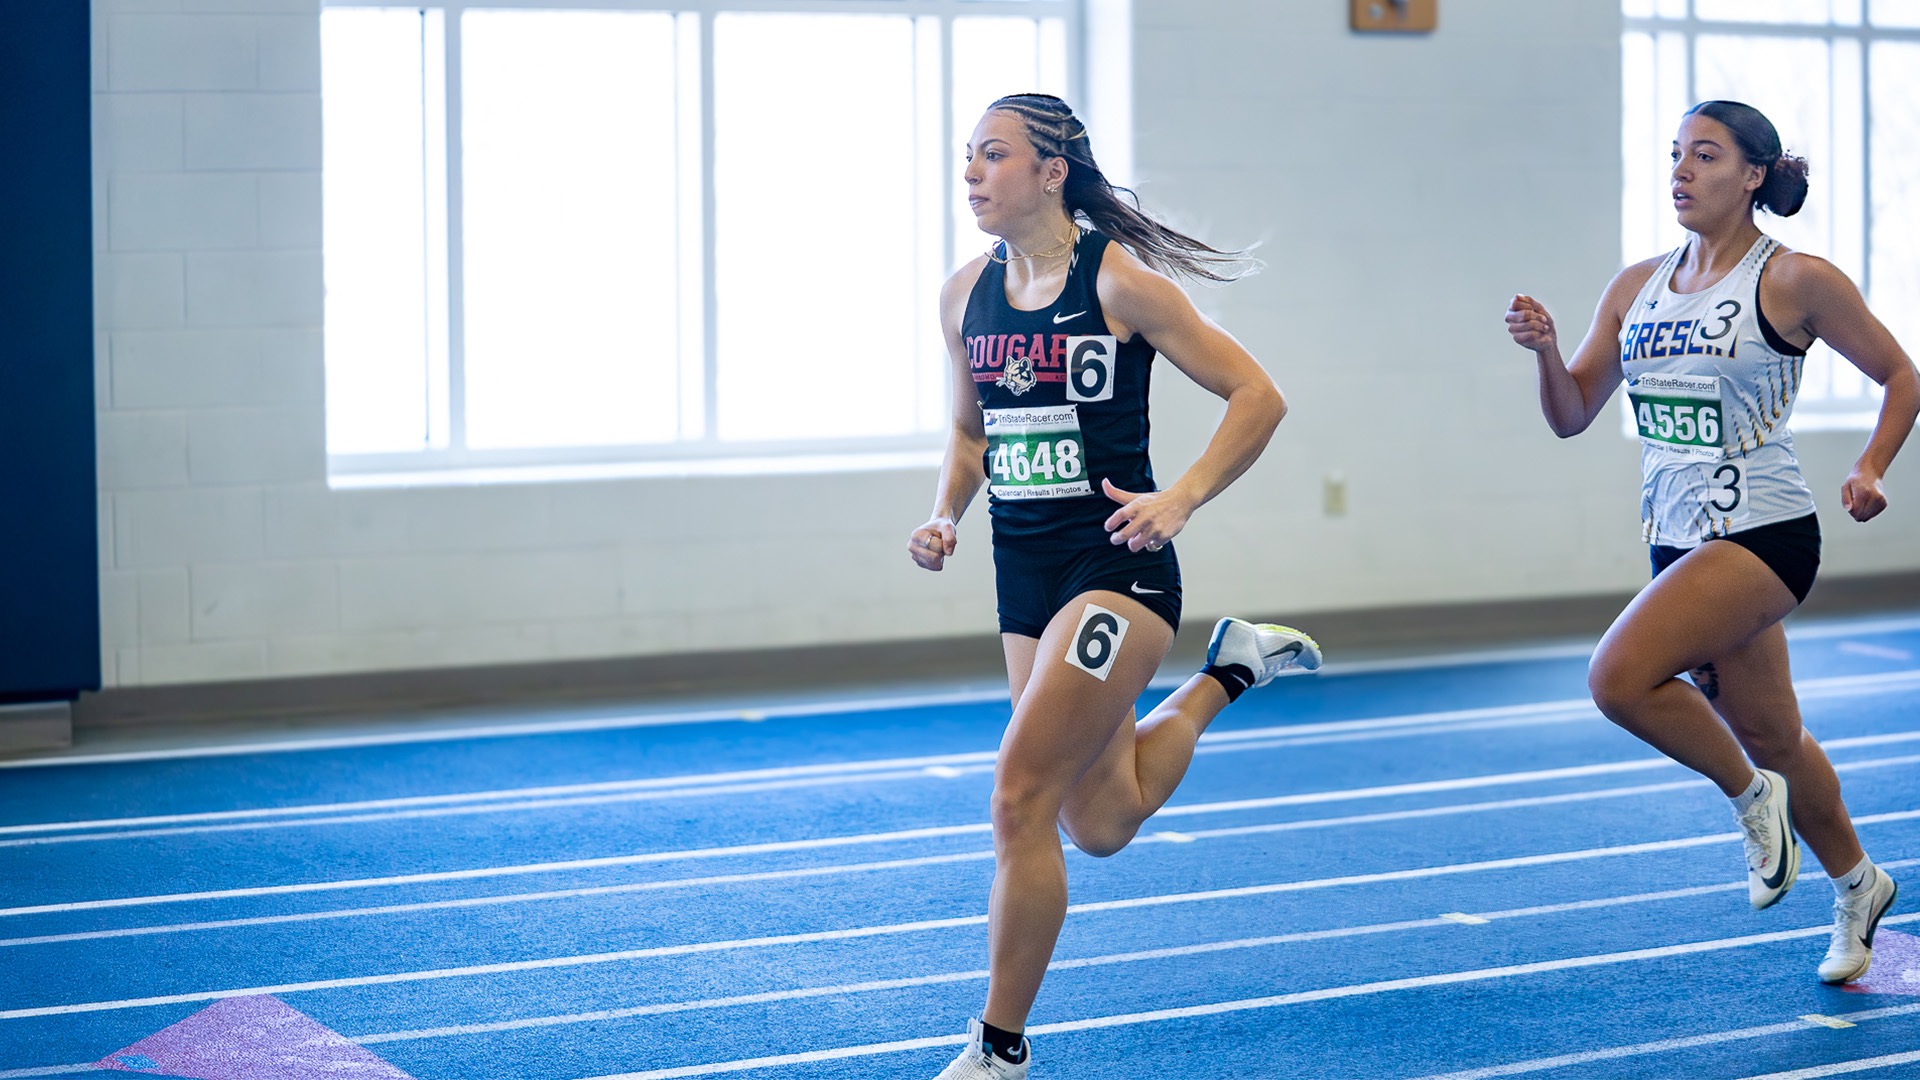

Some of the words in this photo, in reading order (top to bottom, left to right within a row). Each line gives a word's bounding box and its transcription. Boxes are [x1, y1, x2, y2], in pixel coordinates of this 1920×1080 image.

[1622, 319, 1737, 361] BRES
[1700, 299, 1741, 340] 3
[966, 334, 1068, 369] COUGAR
[1071, 339, 1107, 398] 6
[1641, 377, 1716, 390] TriStateRacer.com
[998, 412, 1074, 424] TriStateRacer.com
[1638, 402, 1719, 443] 4556
[993, 439, 1082, 482] 4648
[998, 489, 1022, 497] Calendar
[1027, 488, 1050, 497] Results
[1056, 486, 1081, 495] Photos
[1711, 464, 1741, 512] 3
[1077, 612, 1118, 670] 6
